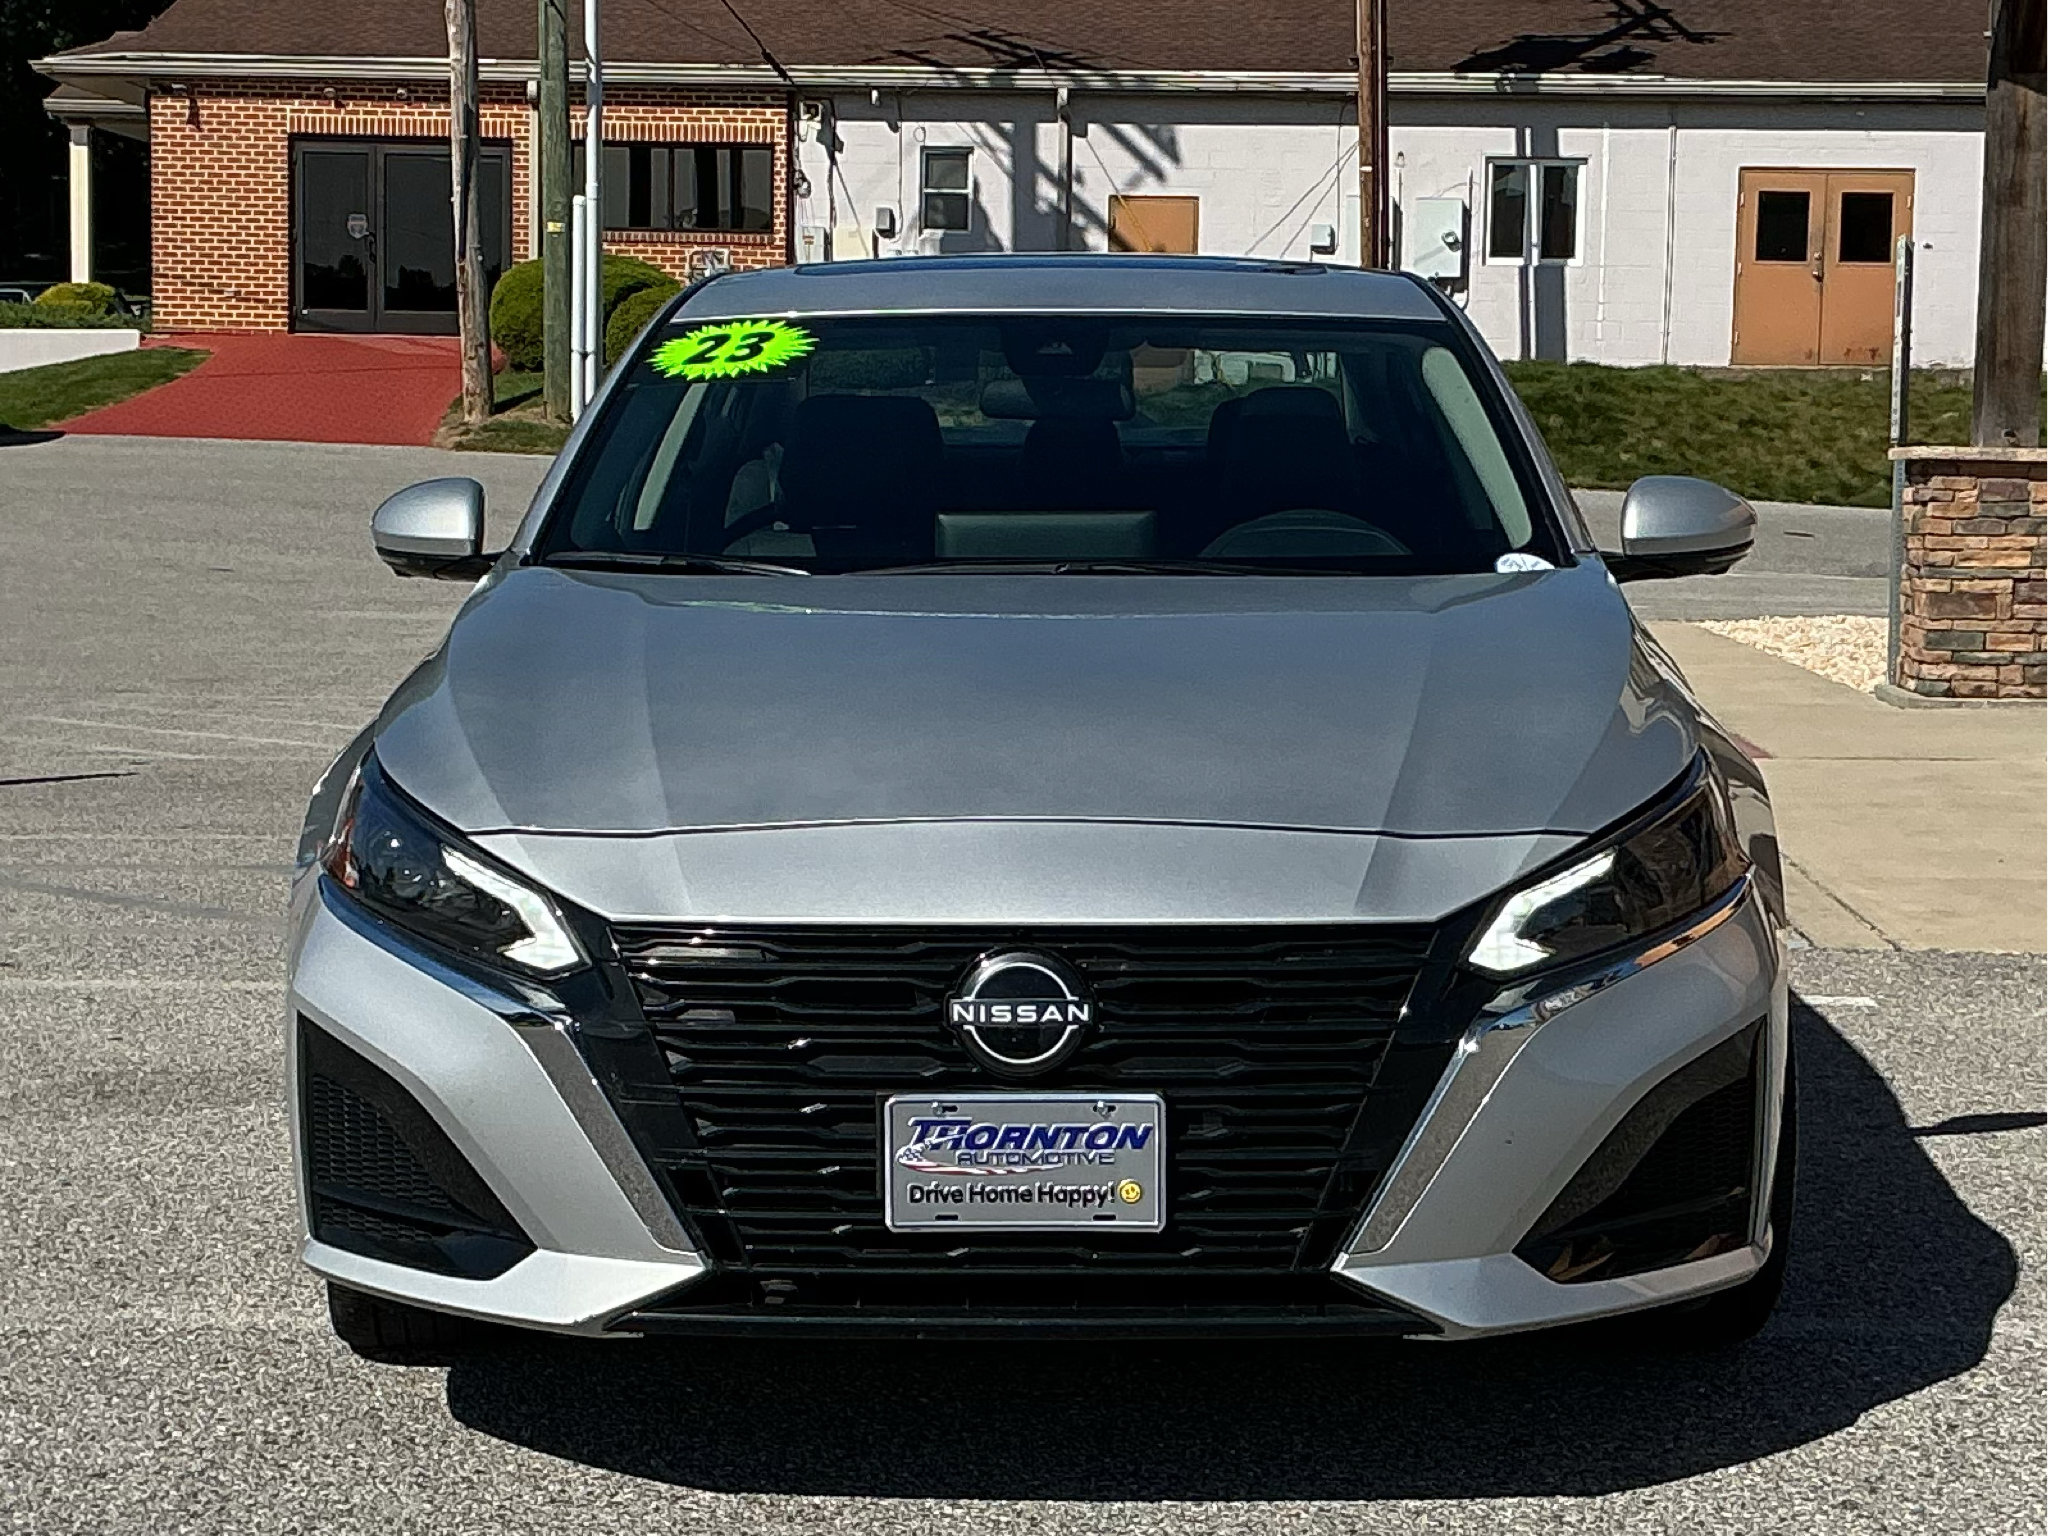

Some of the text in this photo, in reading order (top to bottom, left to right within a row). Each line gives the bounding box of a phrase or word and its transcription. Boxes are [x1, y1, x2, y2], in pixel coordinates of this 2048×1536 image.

[681, 331, 776, 366] 23
[952, 1003, 1089, 1022] NISSAN
[908, 1117, 1154, 1150] THORNTON
[957, 1151, 1115, 1165] AUTOMOTIVE
[908, 1182, 1115, 1208] Drive Home Happy!
